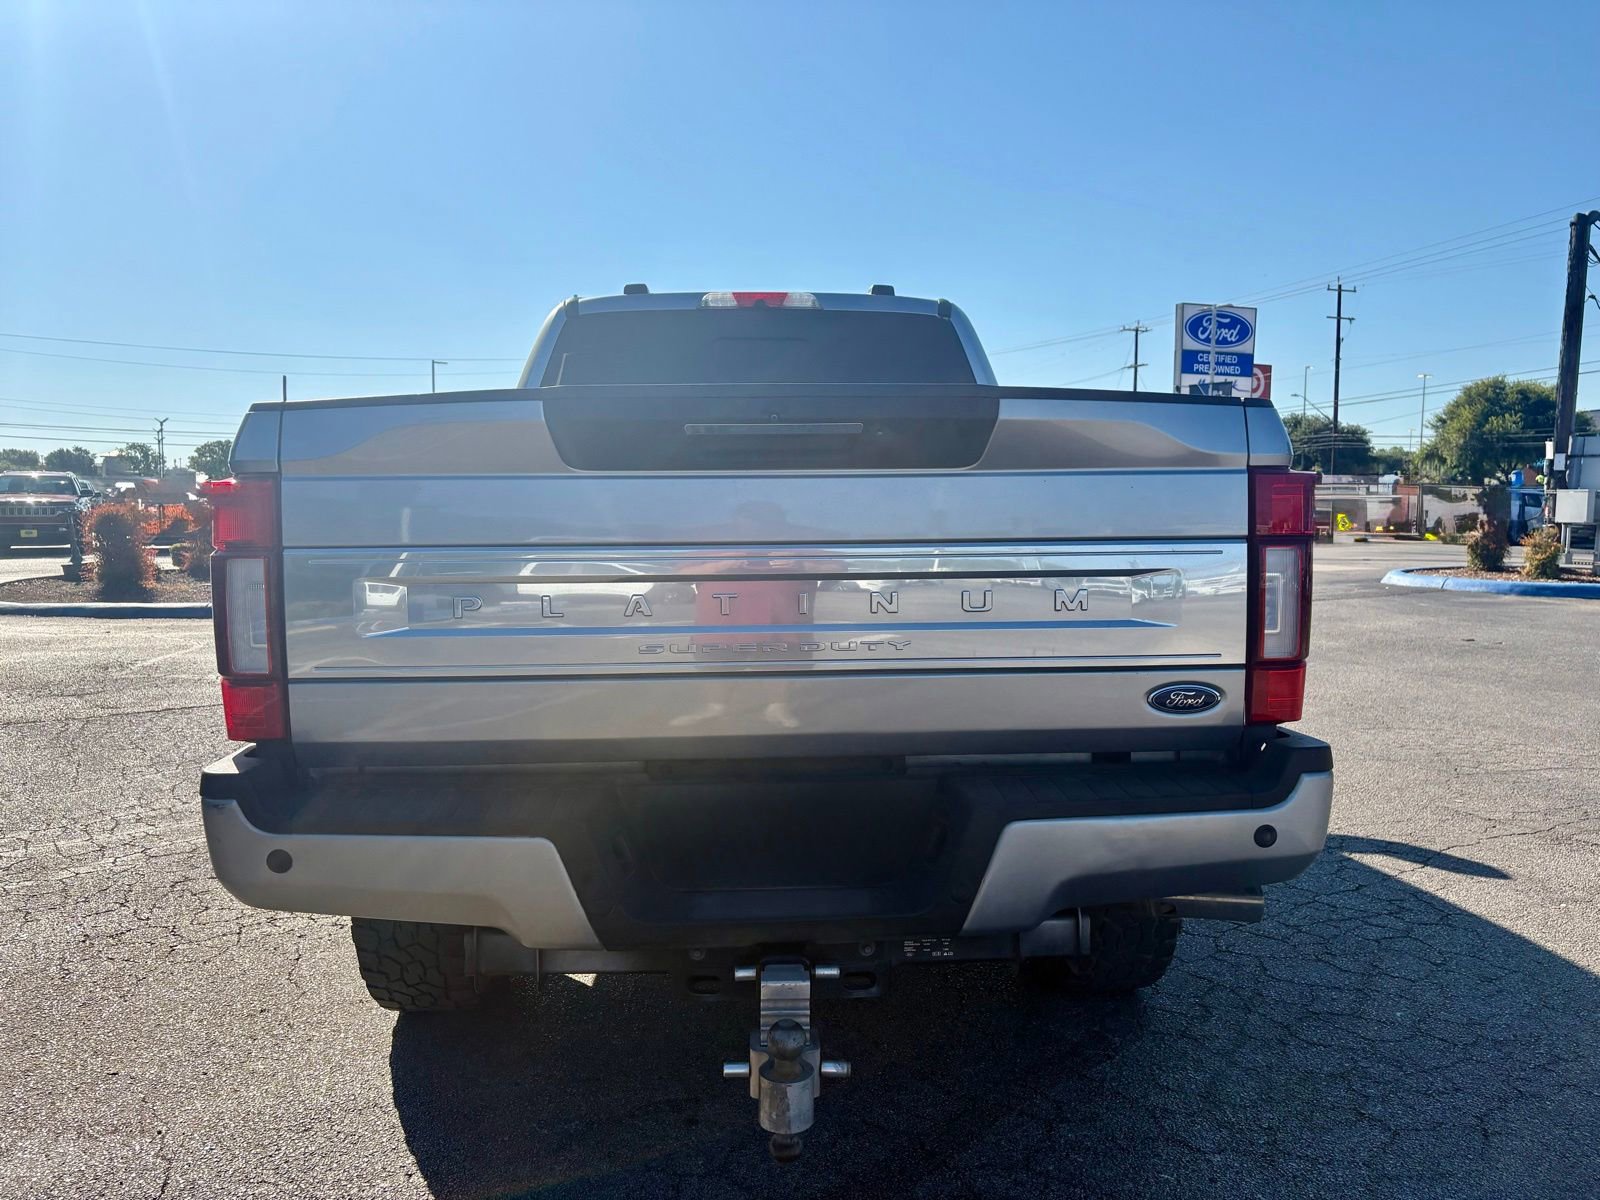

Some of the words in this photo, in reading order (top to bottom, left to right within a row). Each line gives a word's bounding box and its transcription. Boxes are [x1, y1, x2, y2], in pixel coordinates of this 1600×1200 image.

[1197, 353, 1238, 364] CETIFIED
[1193, 363, 1241, 375] PREOWNED
[452, 588, 1089, 619] PLATINUM
[638, 641, 788, 655] SUPER
[799, 640, 912, 652] DUTY
[1166, 690, 1206, 707] Ford
